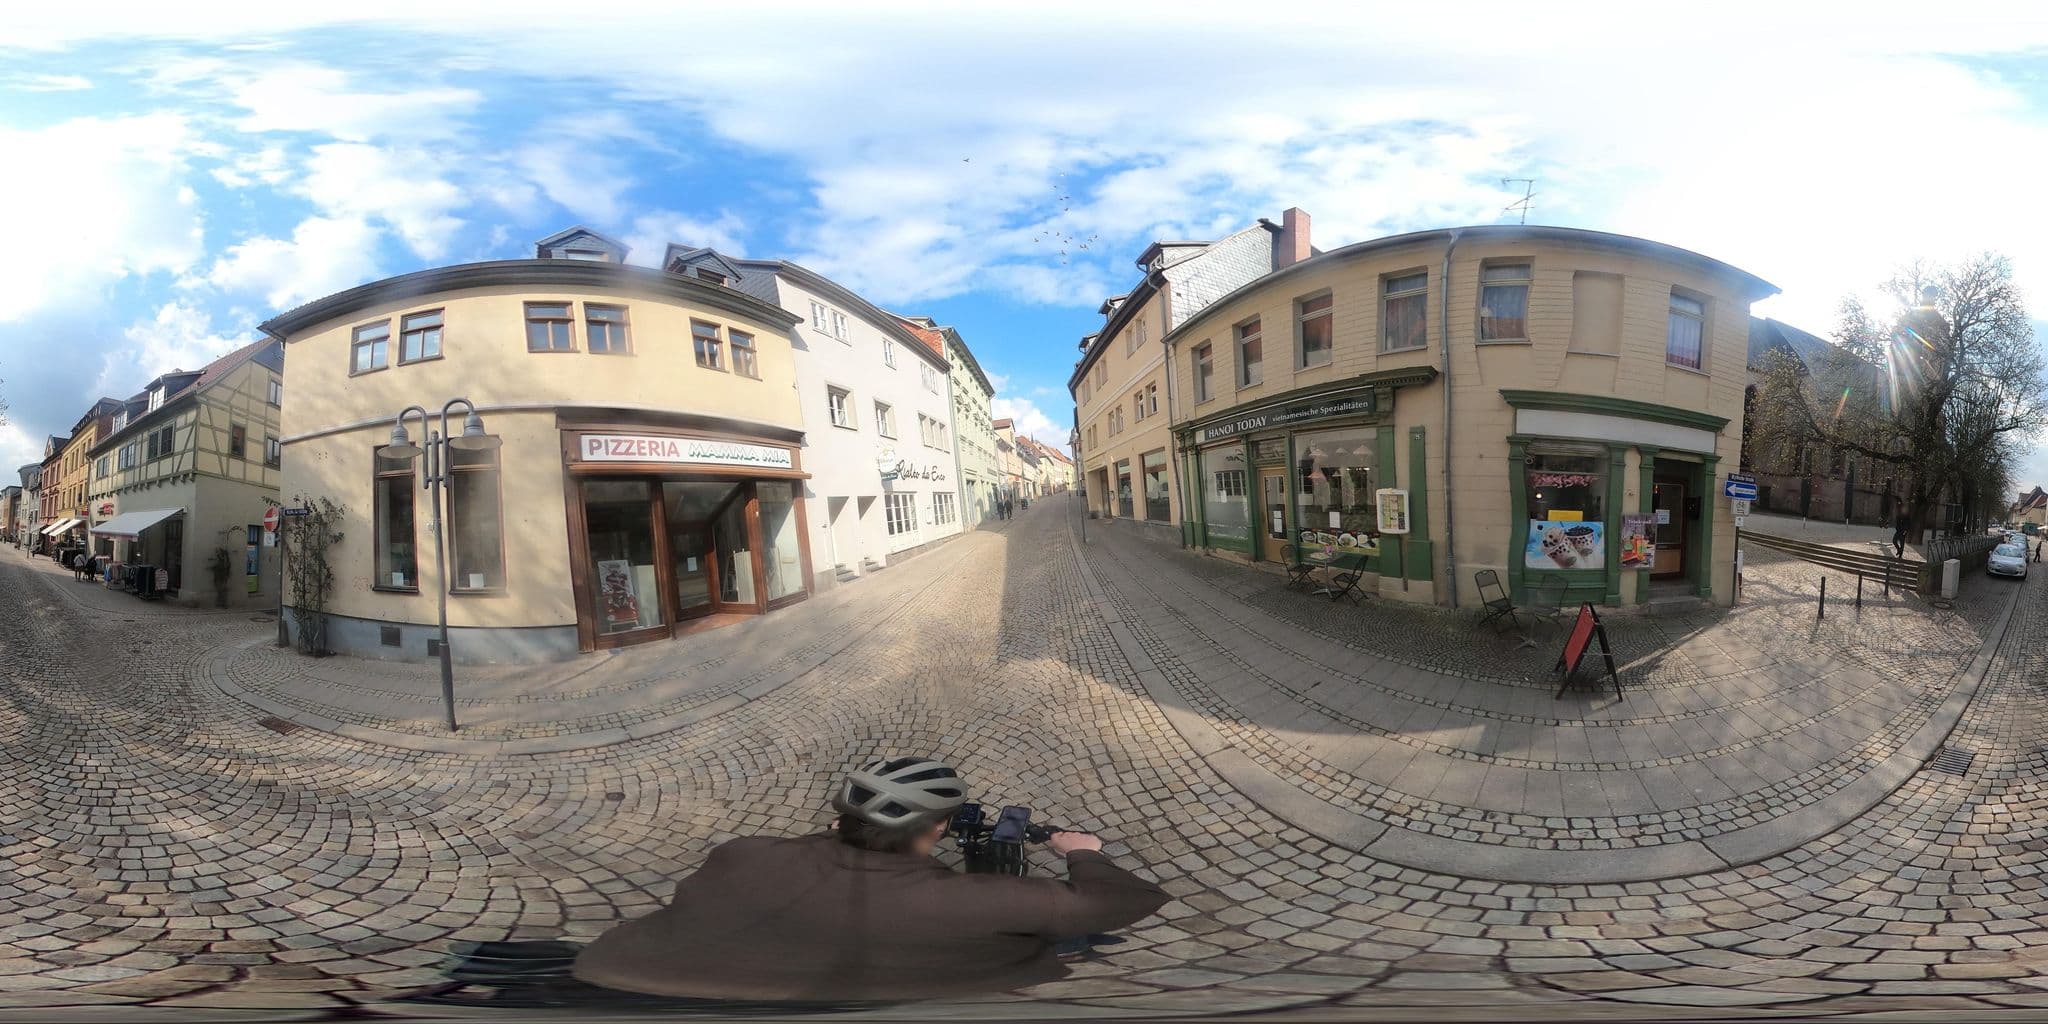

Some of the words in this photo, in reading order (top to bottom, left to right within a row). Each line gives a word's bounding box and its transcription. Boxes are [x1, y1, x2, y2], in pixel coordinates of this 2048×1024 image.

[1272, 407, 1319, 421] vietnamesische
[1319, 401, 1368, 415] Spezialitäten
[1208, 423, 1234, 438] HANOI
[1236, 416, 1267, 431] TODAY
[588, 438, 680, 457] PIZZERIA
[688, 442, 759, 461] MAMMA
[762, 449, 790, 463] MIA
